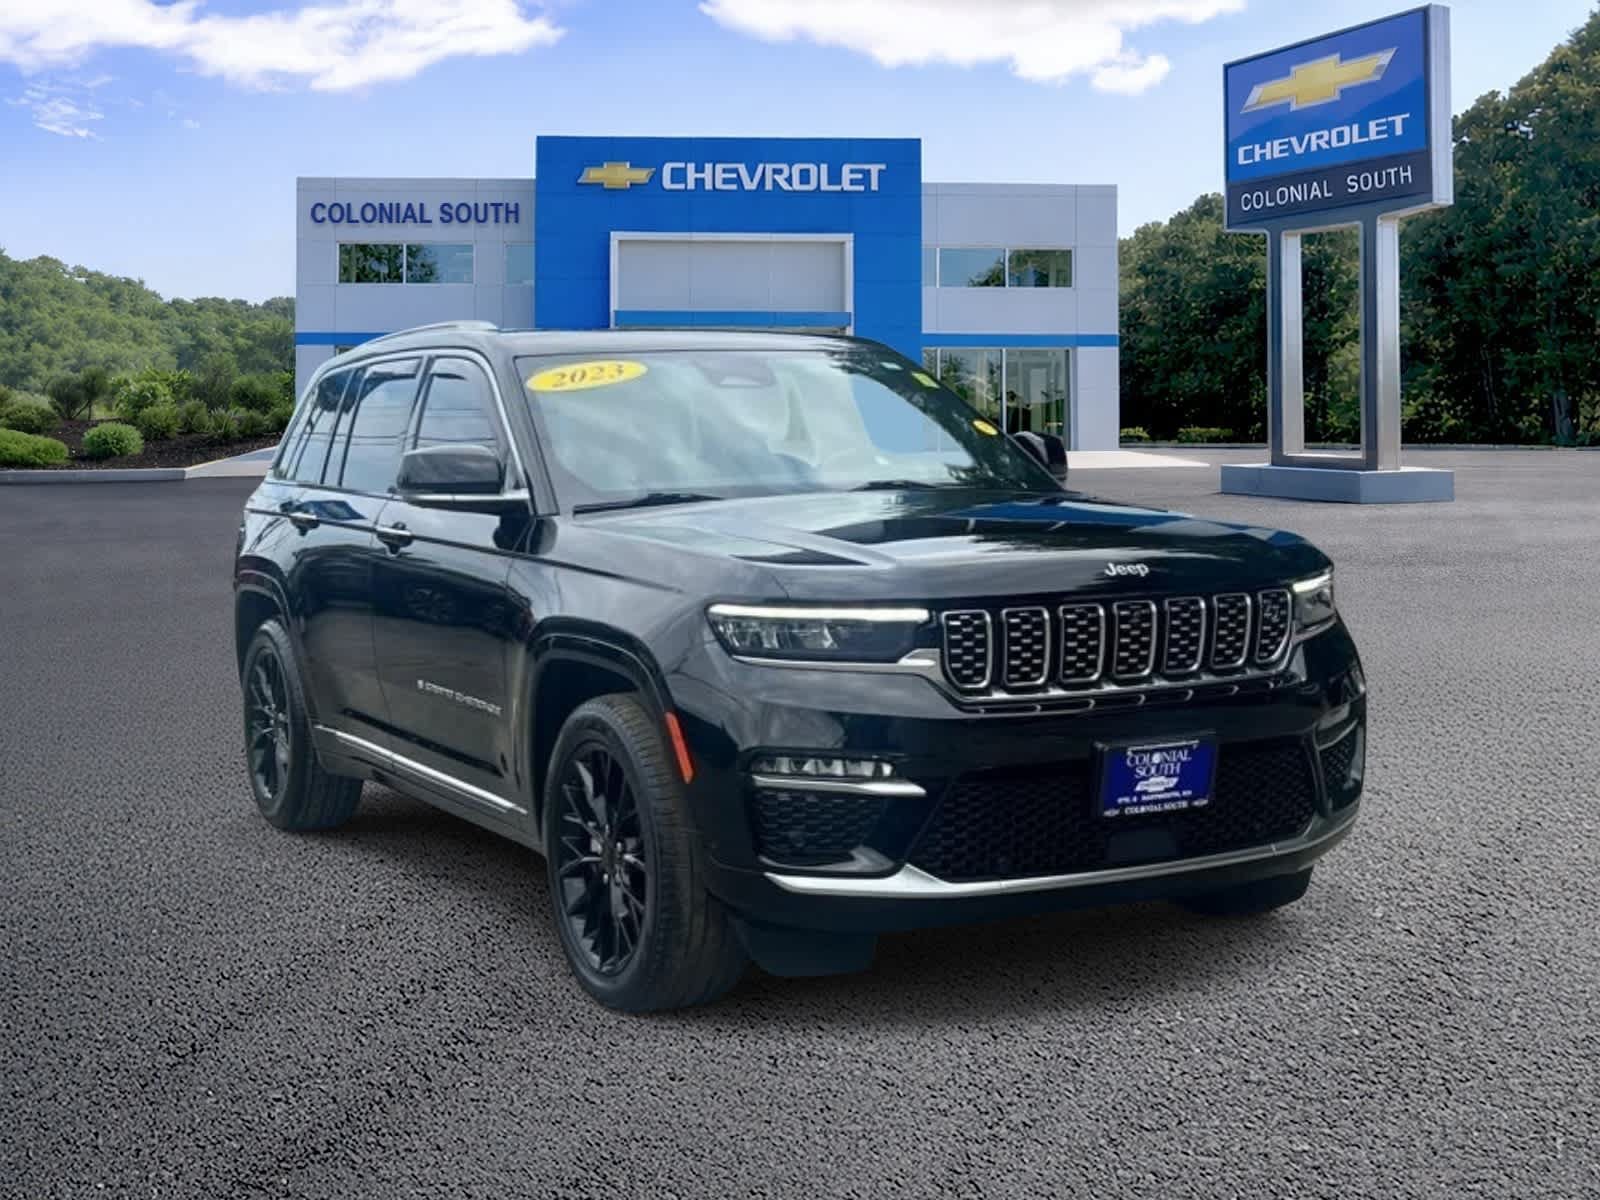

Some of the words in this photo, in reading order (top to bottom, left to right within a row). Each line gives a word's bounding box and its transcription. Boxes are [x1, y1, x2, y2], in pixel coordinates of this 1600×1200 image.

[1238, 113, 1410, 165] CHEVROLET
[662, 162, 887, 191] CHEVROLET
[1241, 180, 1333, 211] COLONIAL
[1347, 165, 1412, 193] SOUTH
[310, 202, 432, 224] COLONIAL
[439, 202, 520, 224] SOUTH
[552, 364, 624, 388] 2023
[1104, 562, 1149, 577] Jeep
[1126, 750, 1192, 767] COLONIAL
[1134, 762, 1181, 779] SOUTH
